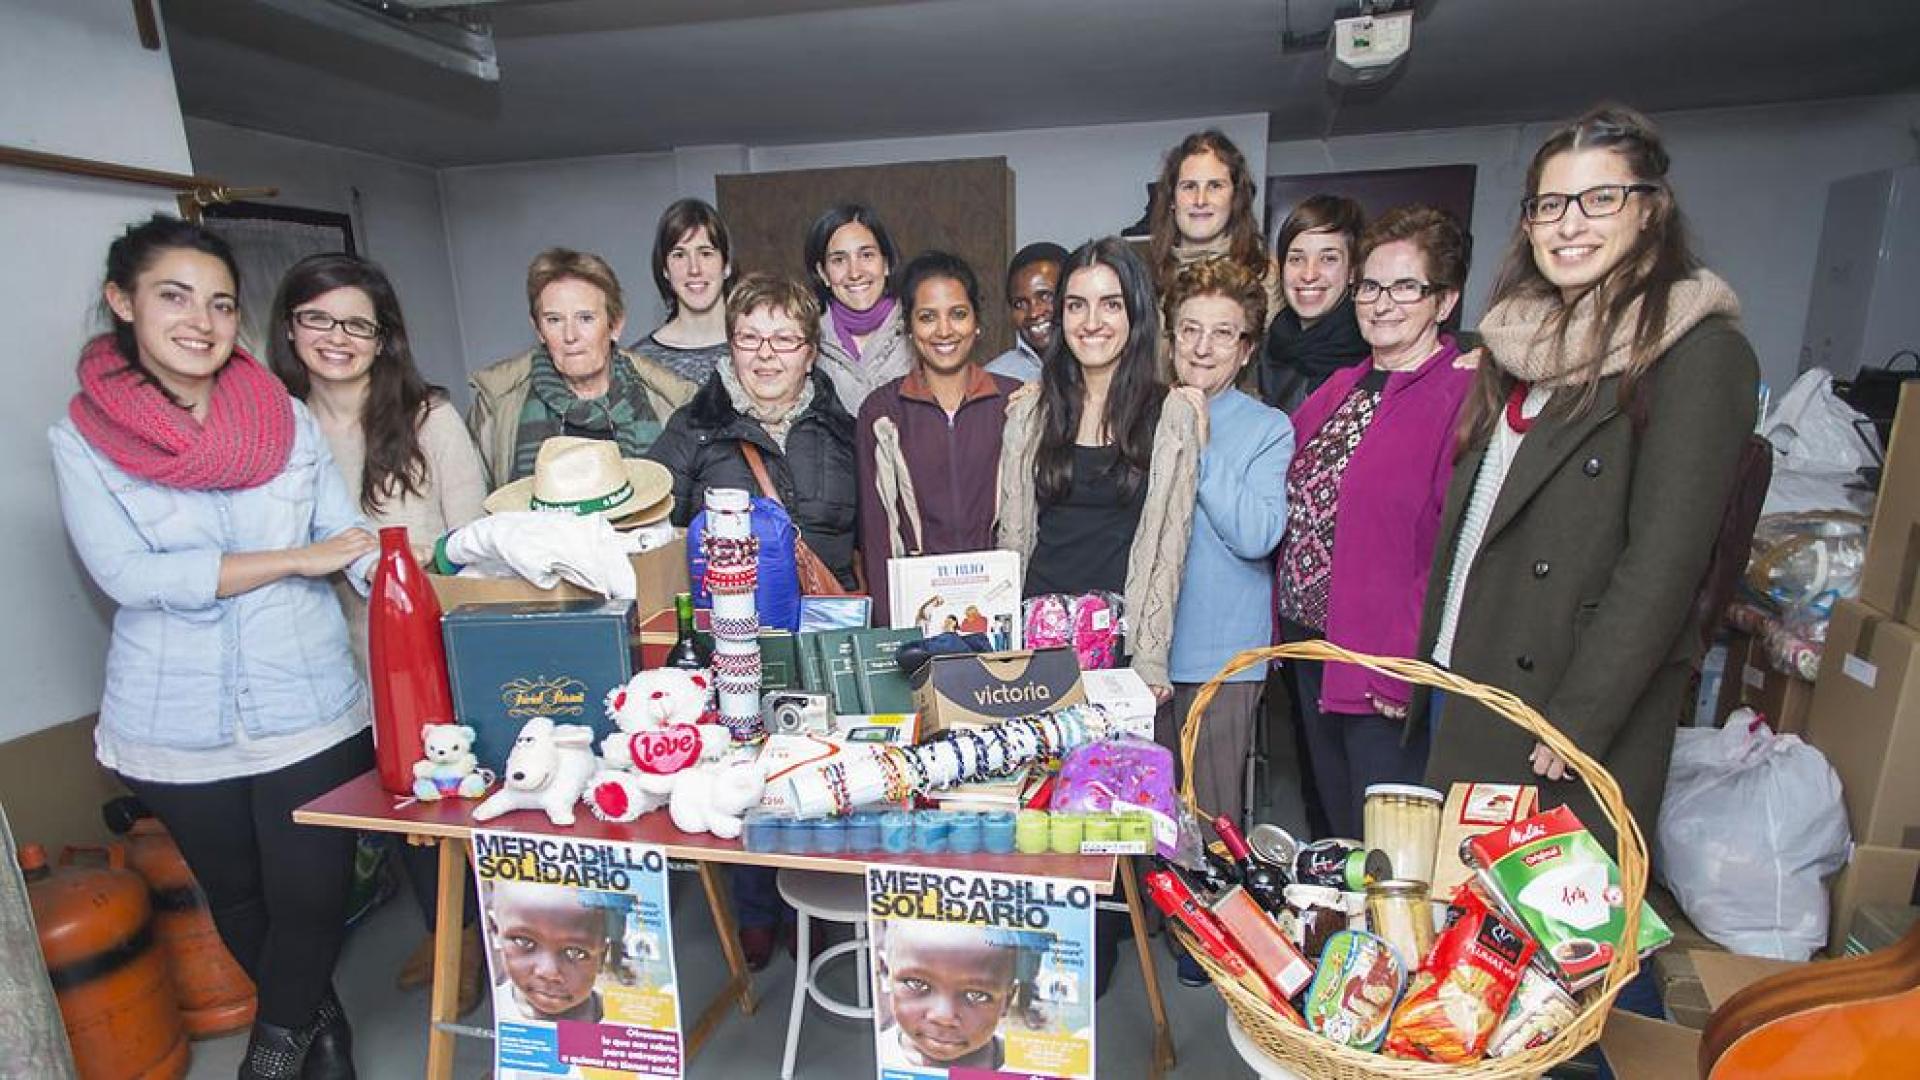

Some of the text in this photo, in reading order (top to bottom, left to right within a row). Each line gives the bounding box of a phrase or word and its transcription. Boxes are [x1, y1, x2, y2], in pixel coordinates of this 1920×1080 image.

[974, 681, 1051, 706] victoria
[476, 833, 664, 873] MERCADILLO
[479, 856, 631, 891] SOLIDARIO
[869, 869, 1091, 909] MERCADILLO
[871, 893, 1050, 929] SOLIDARIO
[613, 1039, 630, 1049] que
